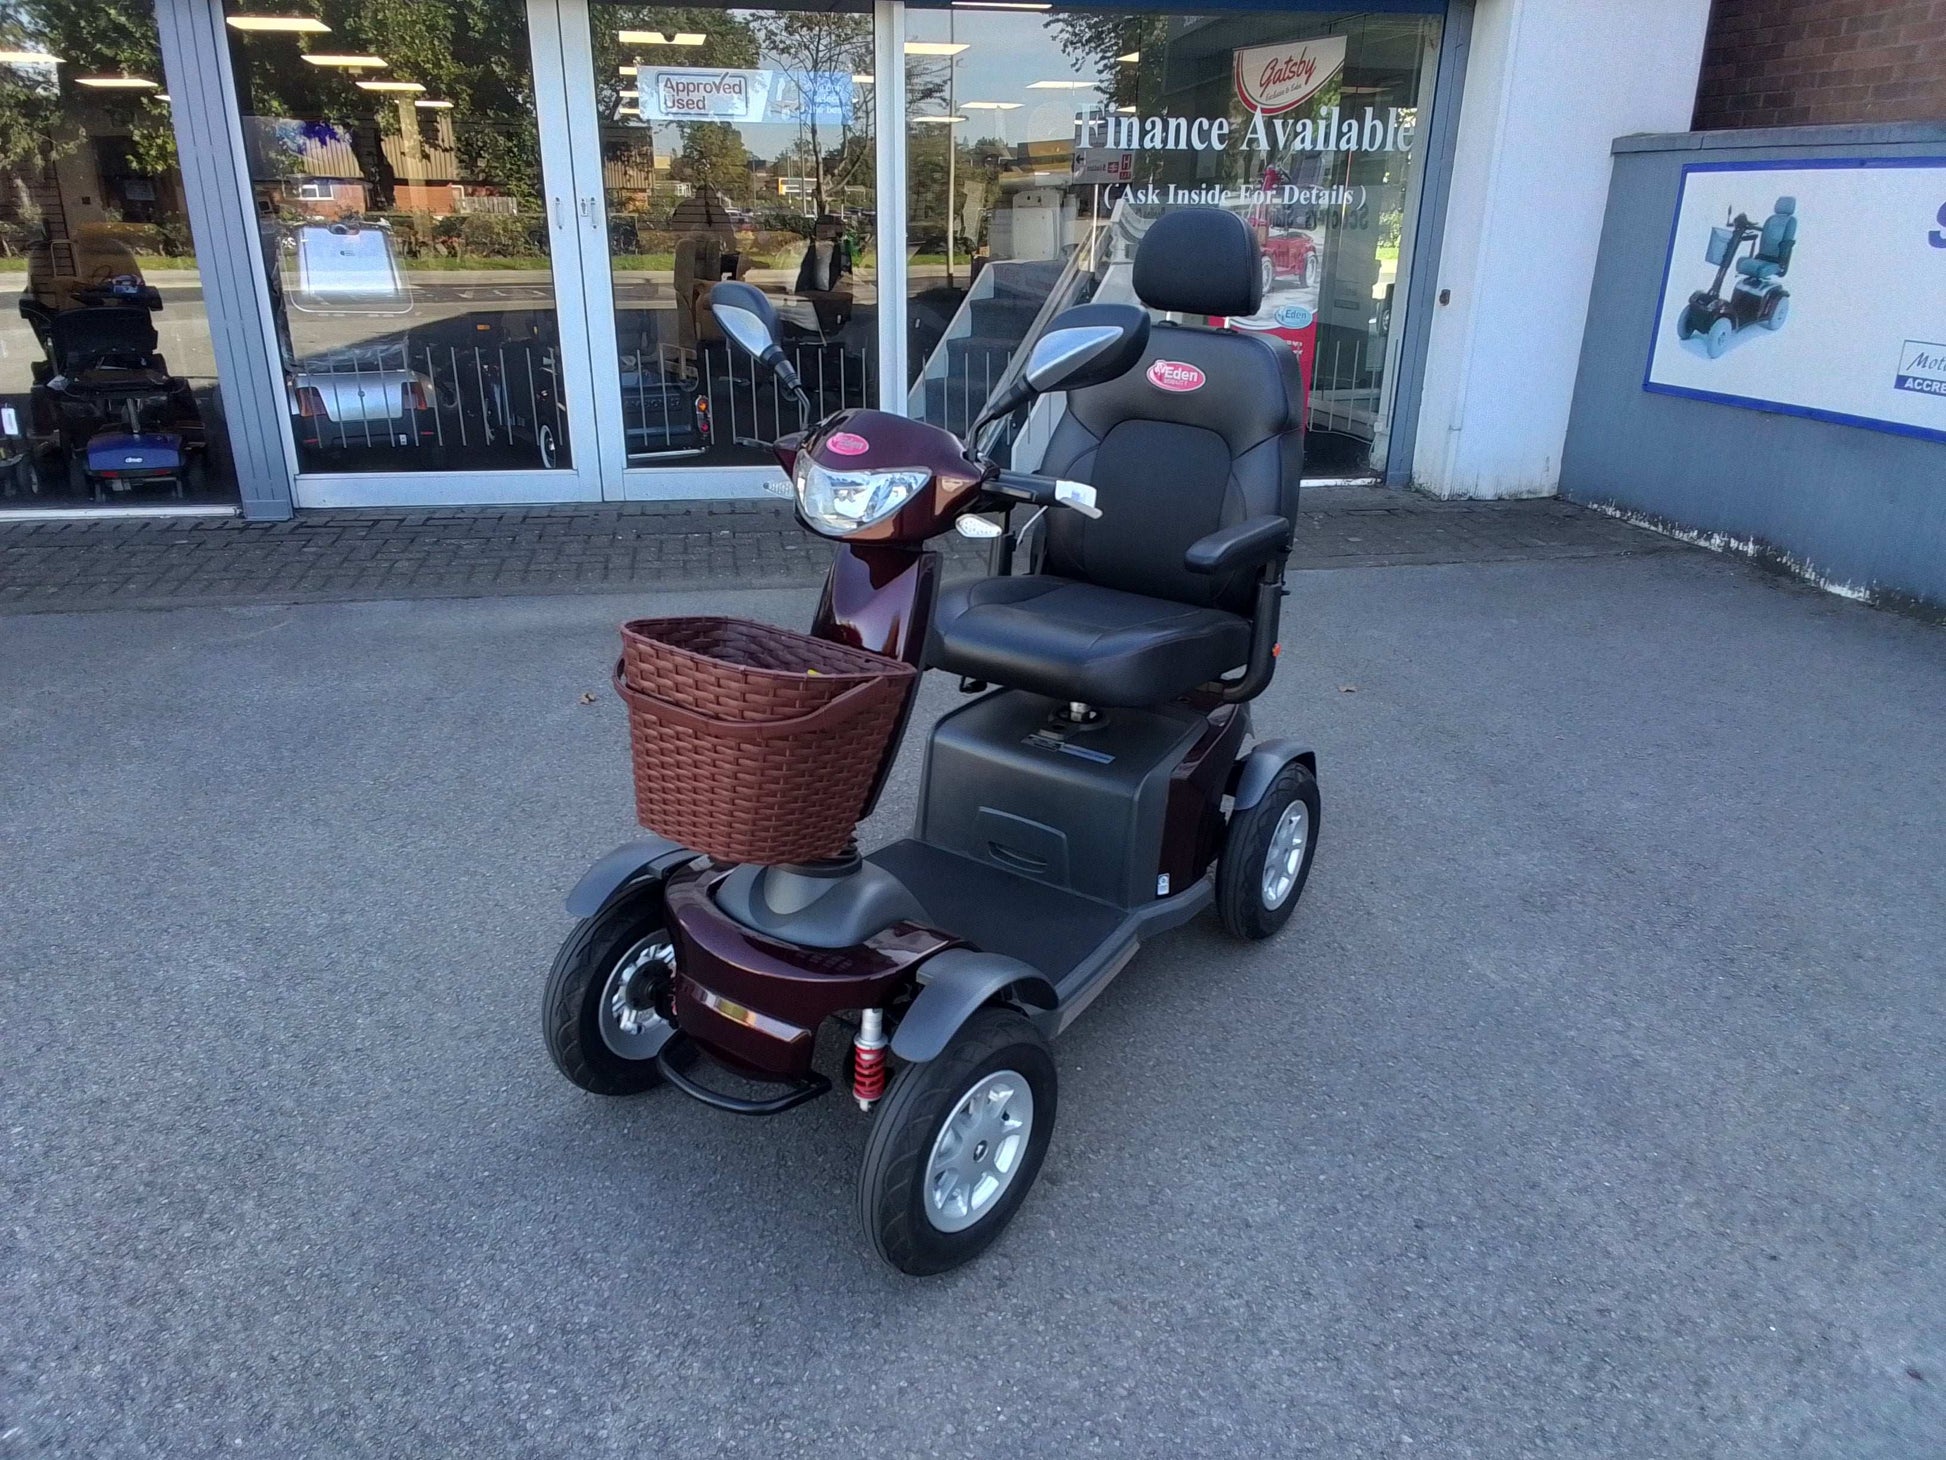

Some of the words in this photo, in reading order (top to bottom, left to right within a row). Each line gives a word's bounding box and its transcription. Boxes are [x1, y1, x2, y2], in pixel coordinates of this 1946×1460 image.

[1260, 46, 1316, 98] Gatsby
[664, 72, 742, 96] Approved
[664, 94, 706, 110] Used
[1075, 102, 1229, 151] Finance
[1239, 105, 1415, 151] Available
[1166, 183, 1231, 205] Inside
[1239, 185, 1277, 205] For
[1285, 309, 1307, 319] Eden
[1165, 366, 1198, 382] Eden
